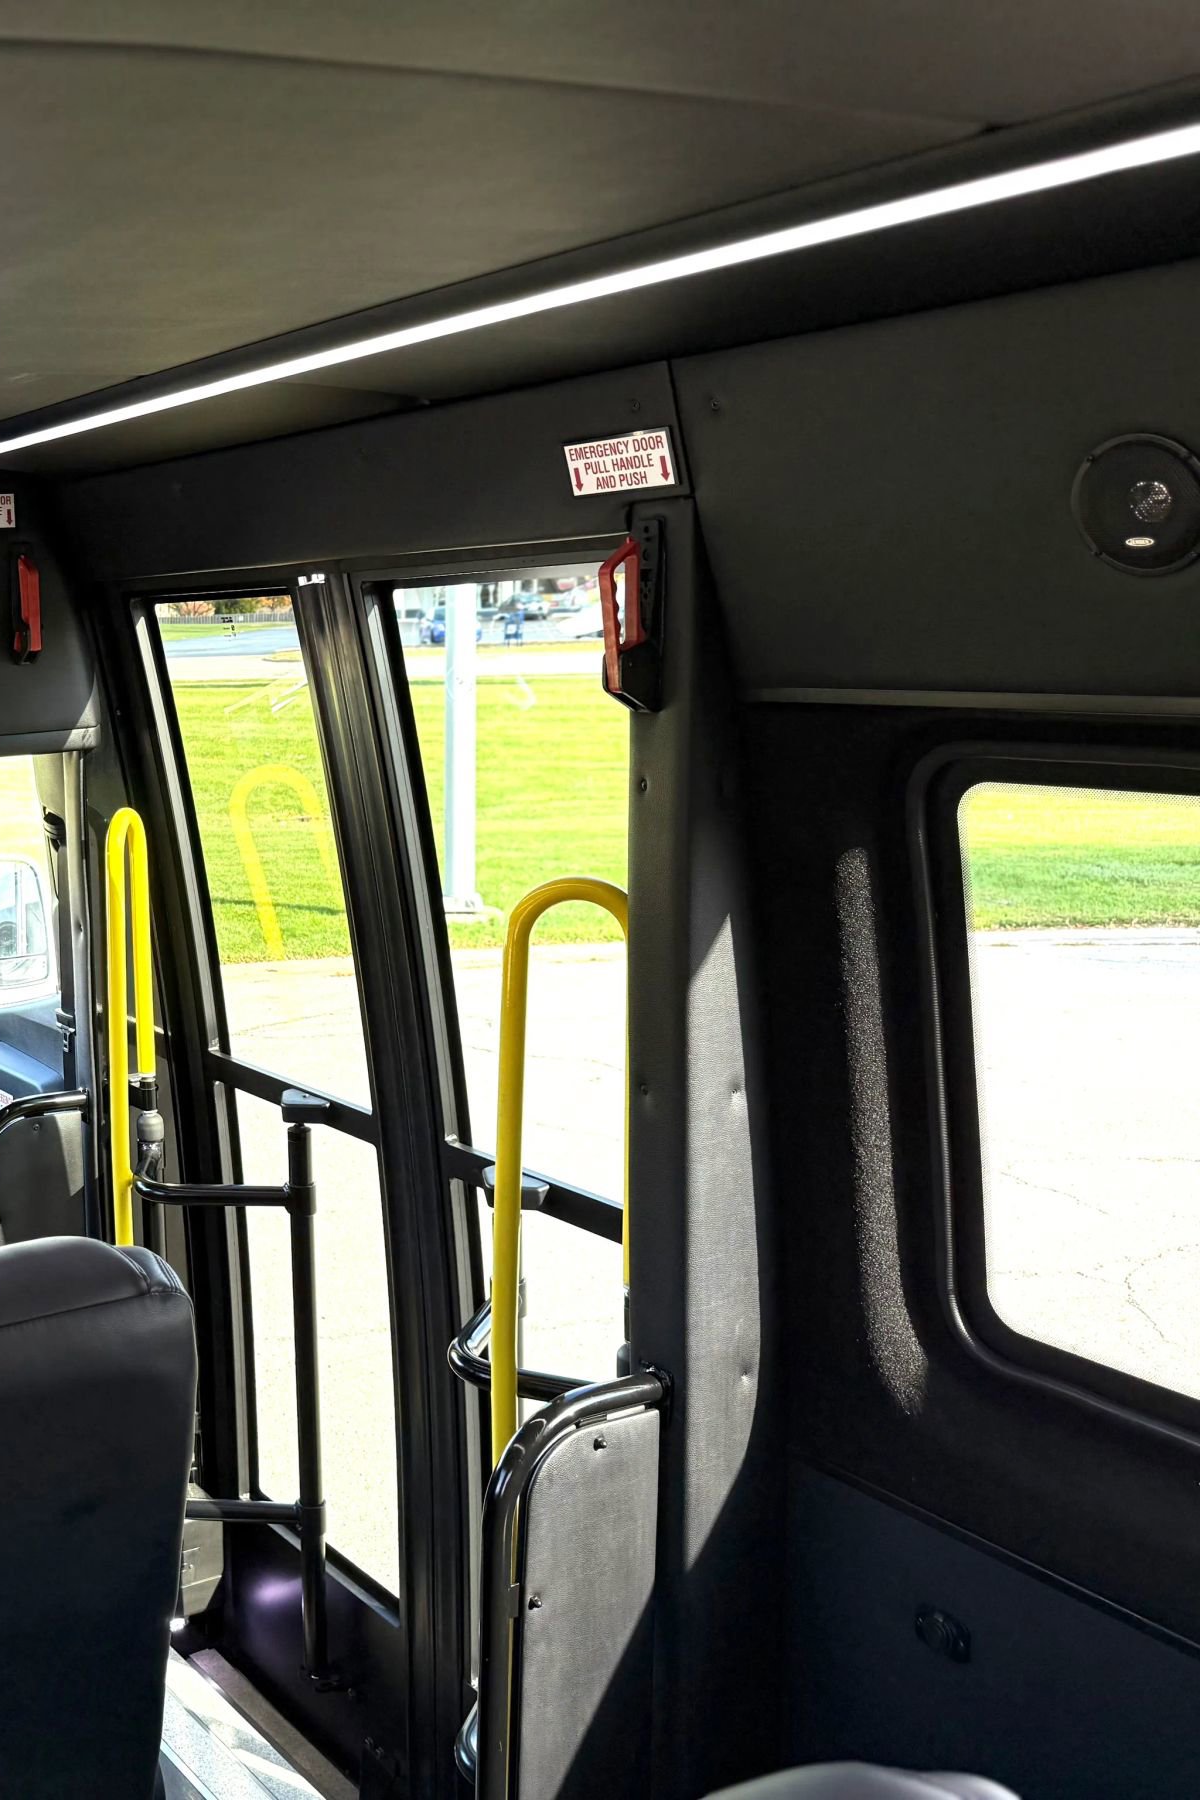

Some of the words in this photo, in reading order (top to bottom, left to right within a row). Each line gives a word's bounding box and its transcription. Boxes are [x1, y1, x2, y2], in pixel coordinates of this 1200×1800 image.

[568, 440, 629, 461] EMERGENCY
[632, 435, 664, 452] DOOR
[584, 460, 610, 475] PULL
[611, 454, 654, 471] HANDLE
[596, 475, 616, 490] AND
[620, 471, 648, 487] PUSH
